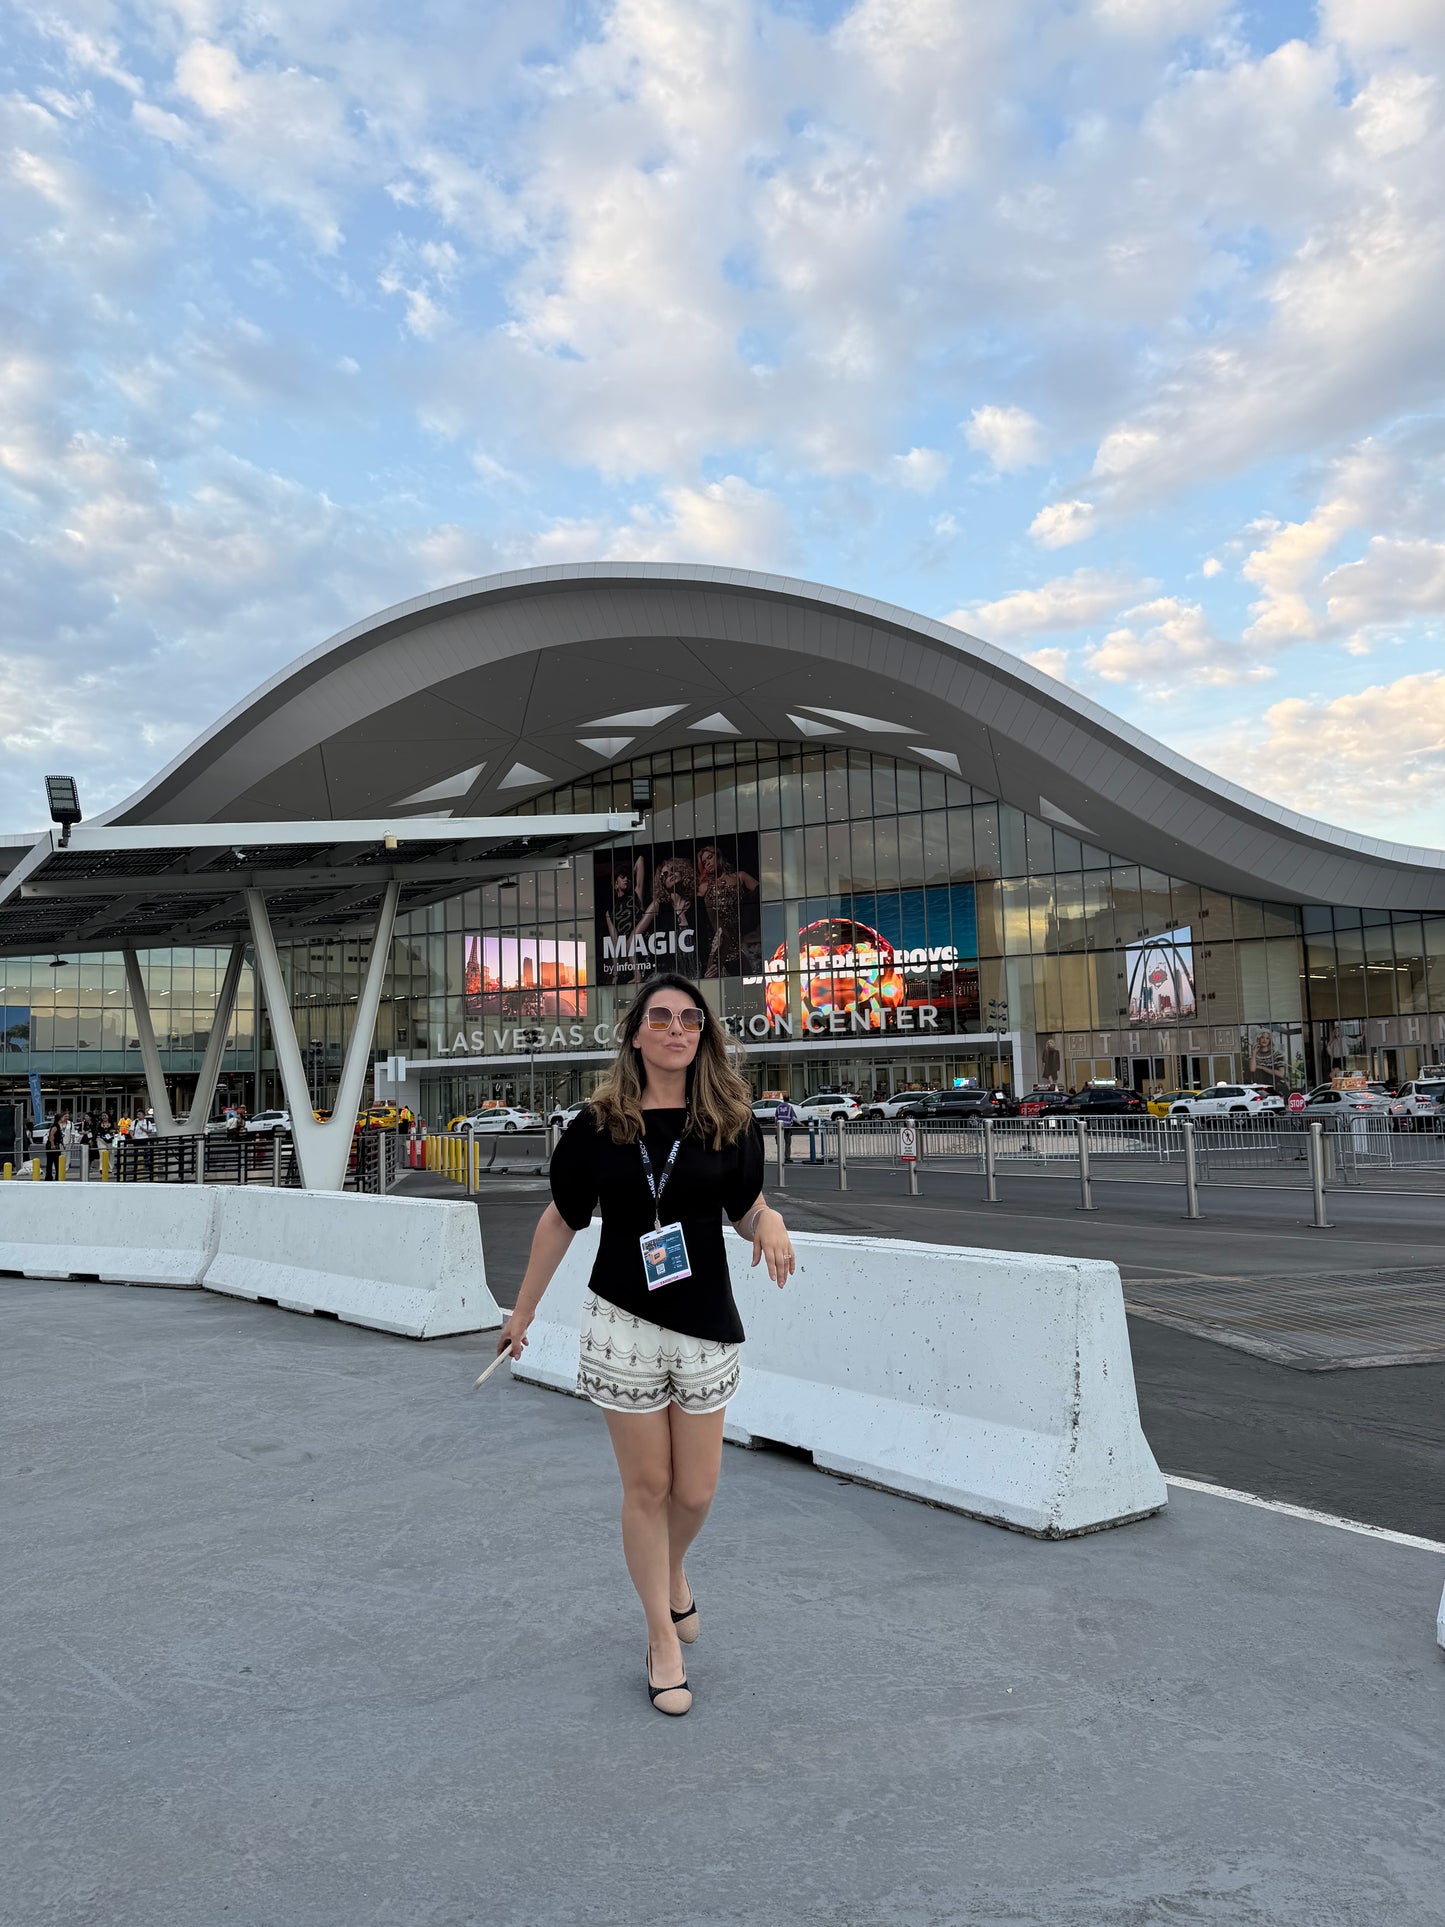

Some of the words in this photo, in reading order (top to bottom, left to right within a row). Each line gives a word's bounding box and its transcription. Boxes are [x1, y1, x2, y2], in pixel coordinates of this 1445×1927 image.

[603, 929, 695, 959] MAGIC
[603, 963, 614, 975] by
[616, 962, 652, 972] informa
[743, 951, 889, 985] ACSTREET
[893, 946, 959, 975] BOYS
[437, 1031, 485, 1053] LAS
[493, 1024, 585, 1050] VEGAS
[806, 1005, 939, 1034] CENTER
[1289, 1099, 1305, 1108] STOP
[667, 1140, 681, 1164] MAGIC
